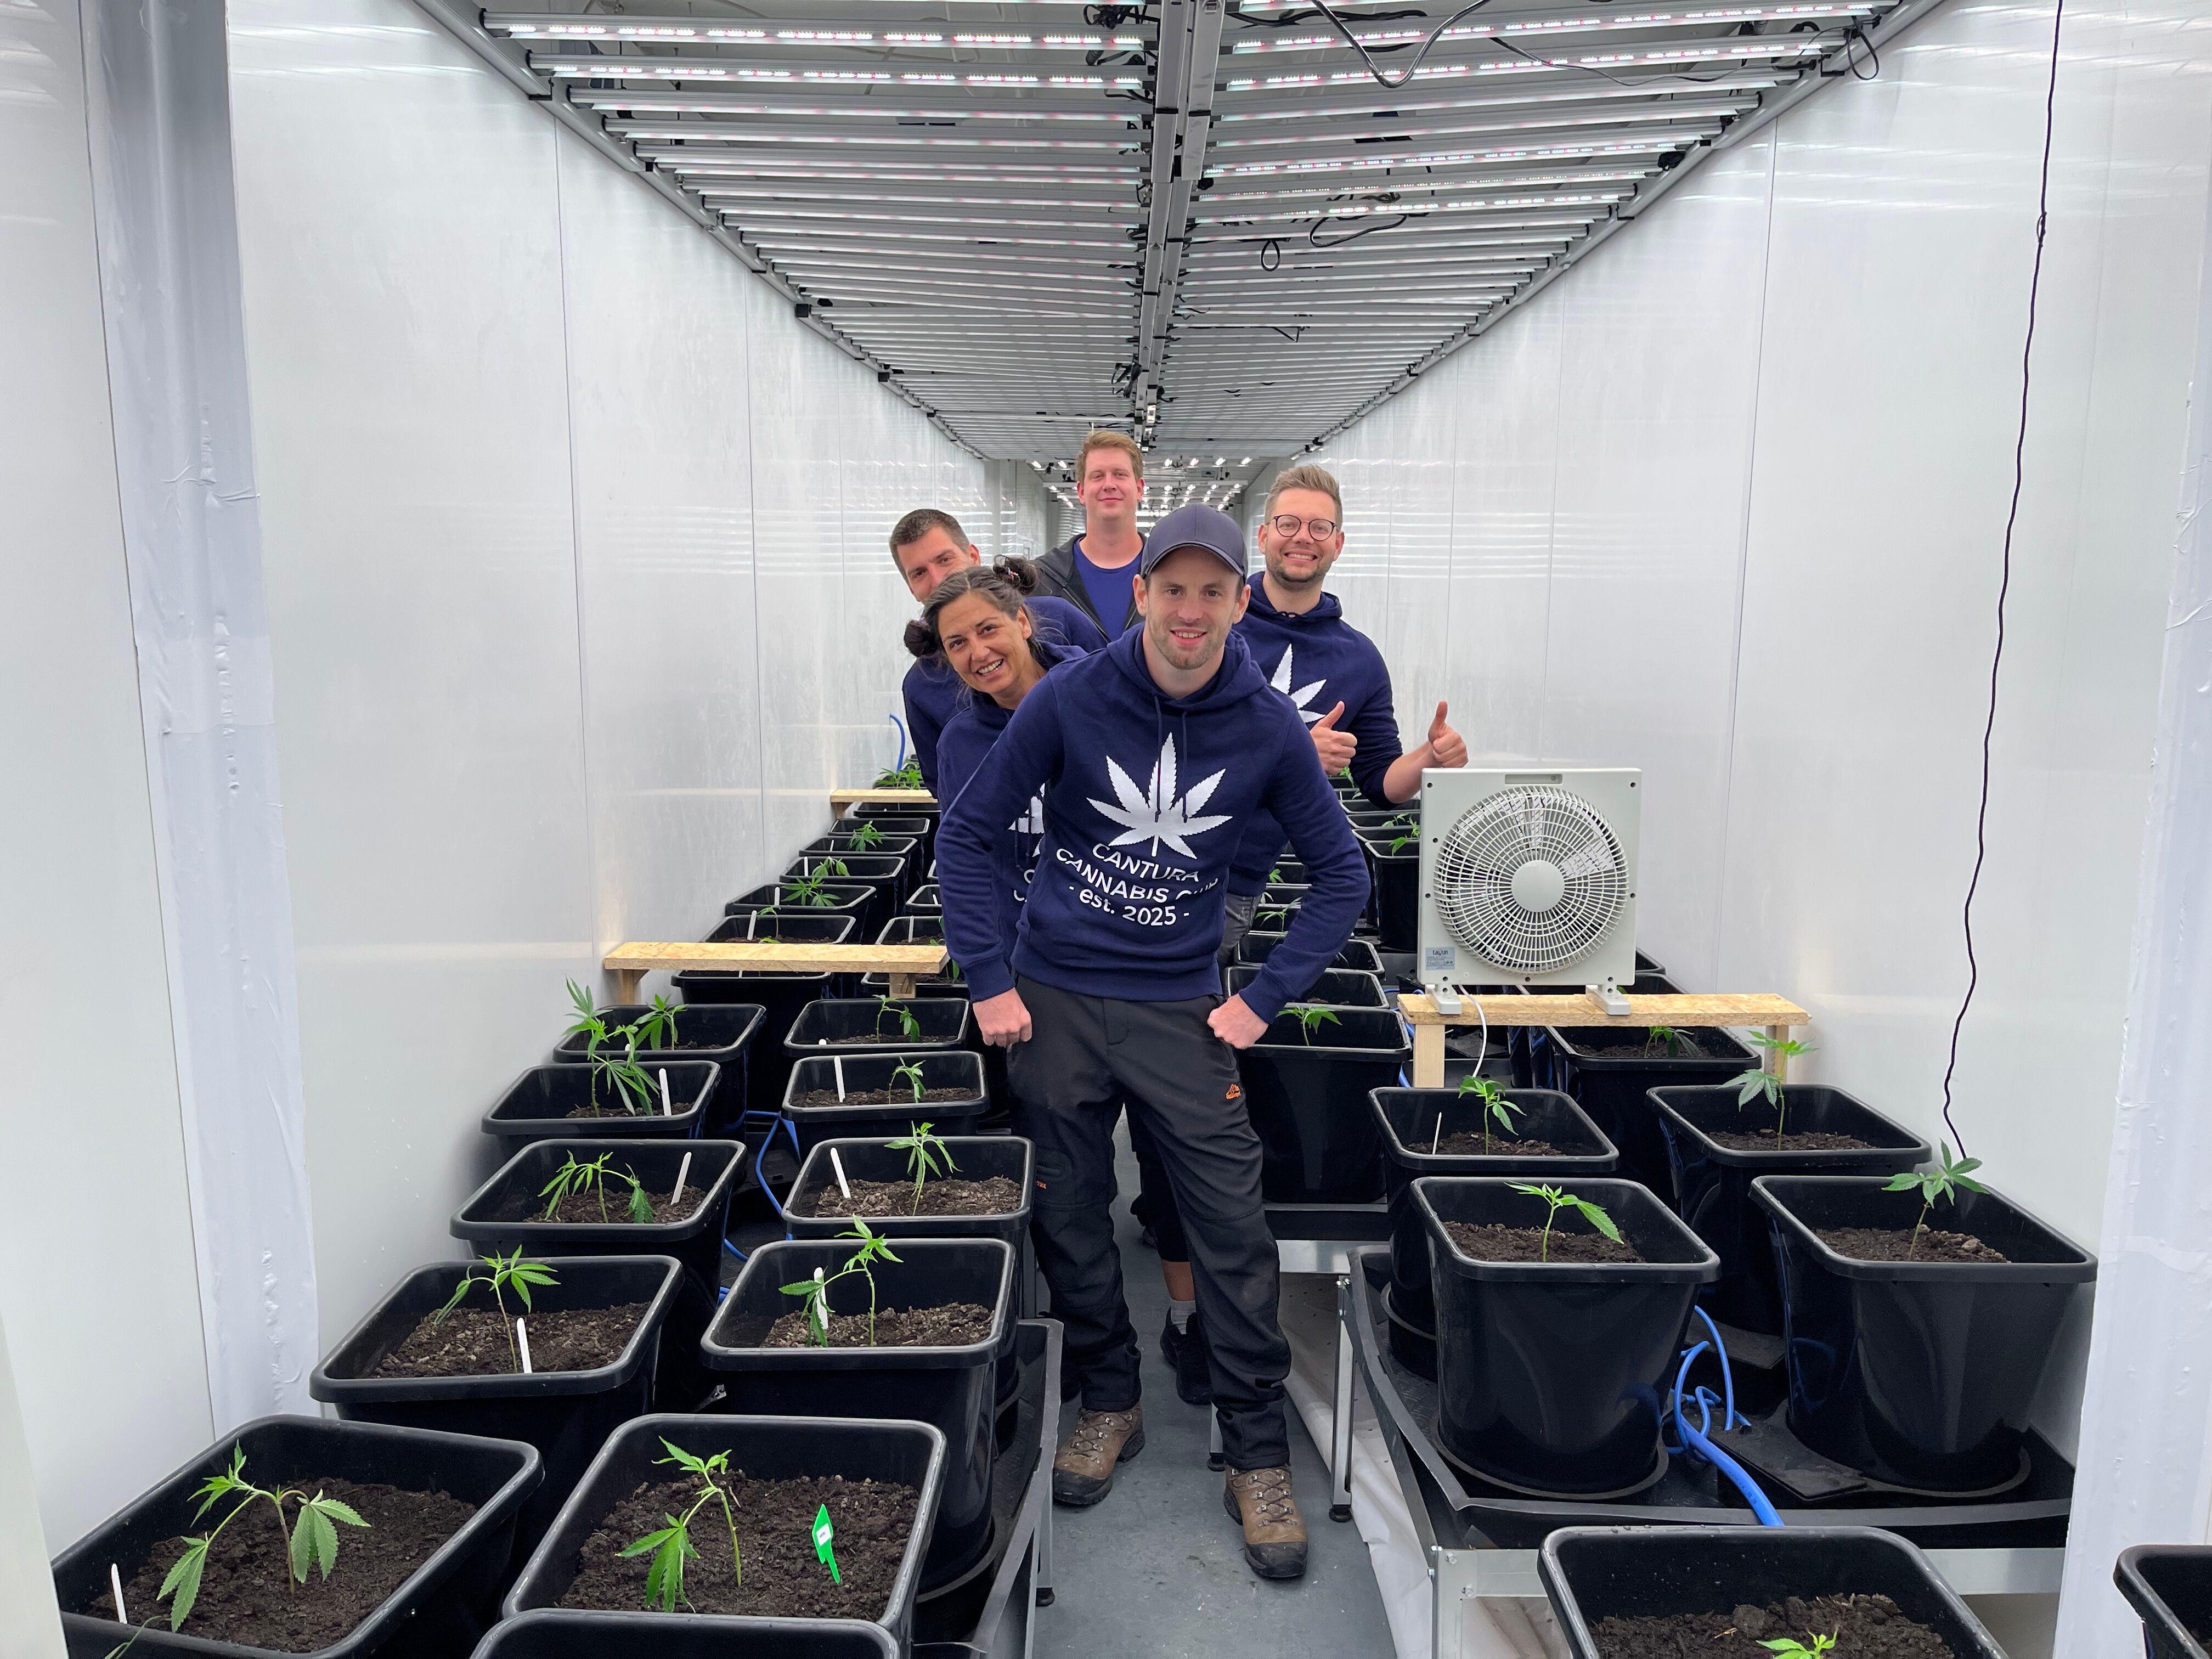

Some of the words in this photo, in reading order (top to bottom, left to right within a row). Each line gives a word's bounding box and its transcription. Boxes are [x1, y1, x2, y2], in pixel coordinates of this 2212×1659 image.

[1056, 848, 1170, 903] CANNABIS
[1092, 843, 1199, 882] CANTURA
[1079, 889, 1115, 914] est.
[1122, 905, 1177, 926] 2025
